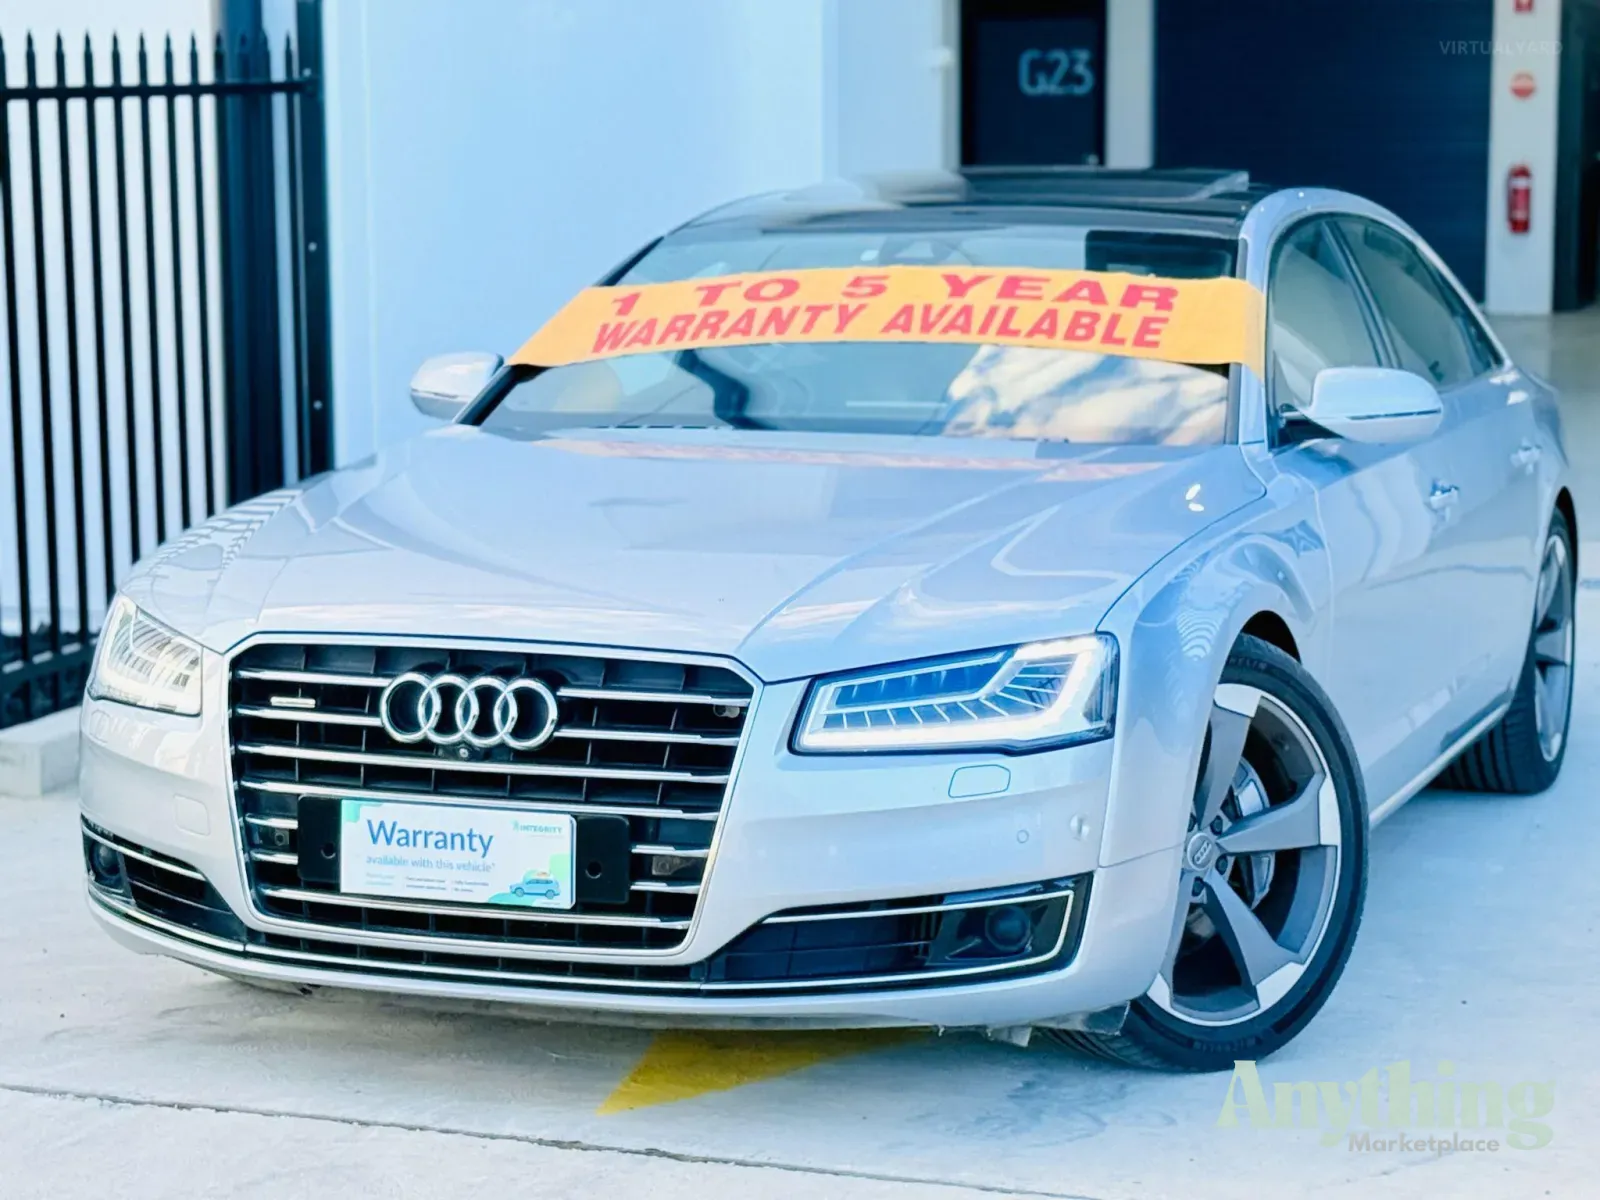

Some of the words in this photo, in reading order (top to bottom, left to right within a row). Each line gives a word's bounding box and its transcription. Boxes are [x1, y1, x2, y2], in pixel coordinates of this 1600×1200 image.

[1019, 48, 1094, 95] G23
[612, 292, 641, 316] 1
[694, 278, 800, 308] TO
[841, 275, 891, 298] 5
[941, 274, 1179, 311] YEAR
[591, 303, 869, 353] WARRANTY
[881, 303, 1170, 348] AVAILABLE
[366, 818, 494, 859] Warranty
[366, 854, 408, 867] available
[411, 857, 433, 869] with
[436, 858, 454, 870] this
